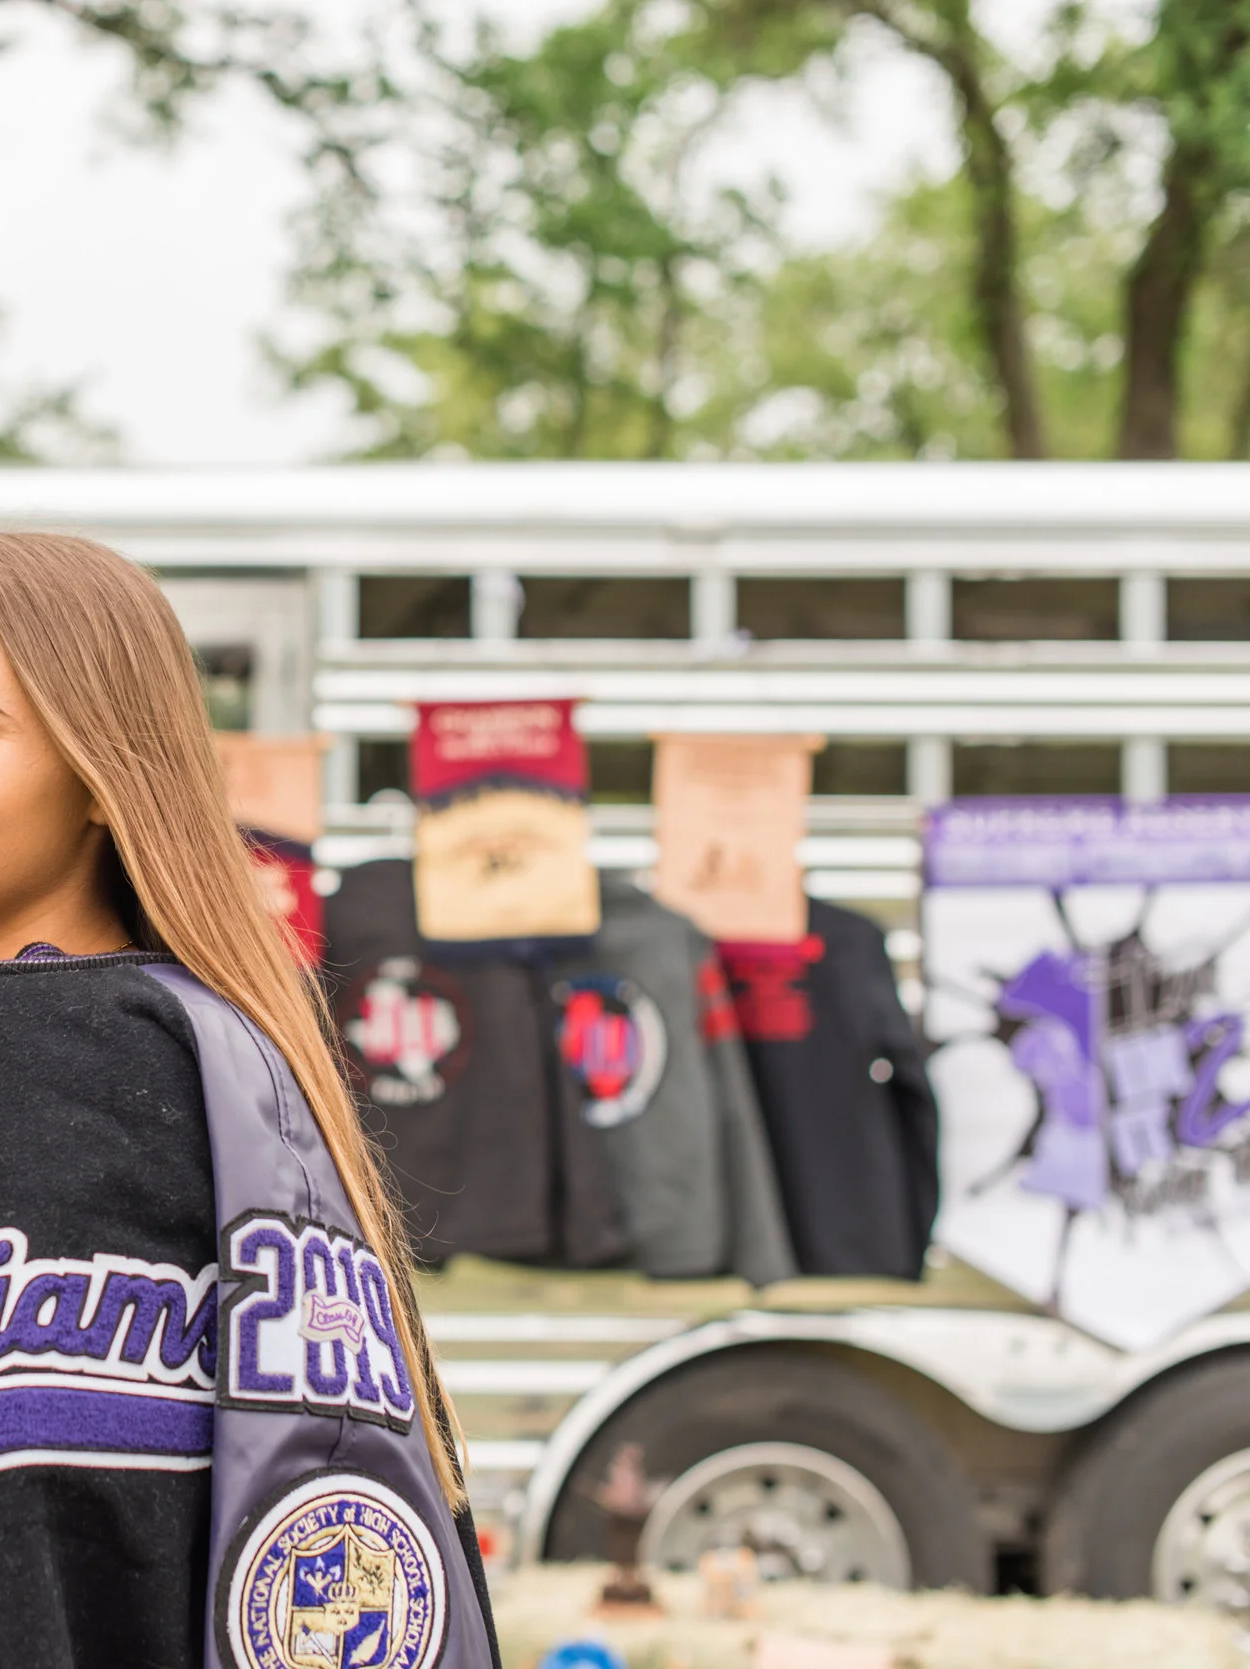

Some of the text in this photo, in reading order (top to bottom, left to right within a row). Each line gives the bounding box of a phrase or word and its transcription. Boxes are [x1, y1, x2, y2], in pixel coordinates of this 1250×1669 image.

[237, 1227, 412, 1412] 2019
[278, 1504, 338, 1555] SOCIETY
[359, 1505, 391, 1536] HIGH
[391, 1527, 423, 1595] SCHOOL
[251, 1553, 283, 1646] NATIONAL
[393, 1597, 425, 1669] SCHOLA
